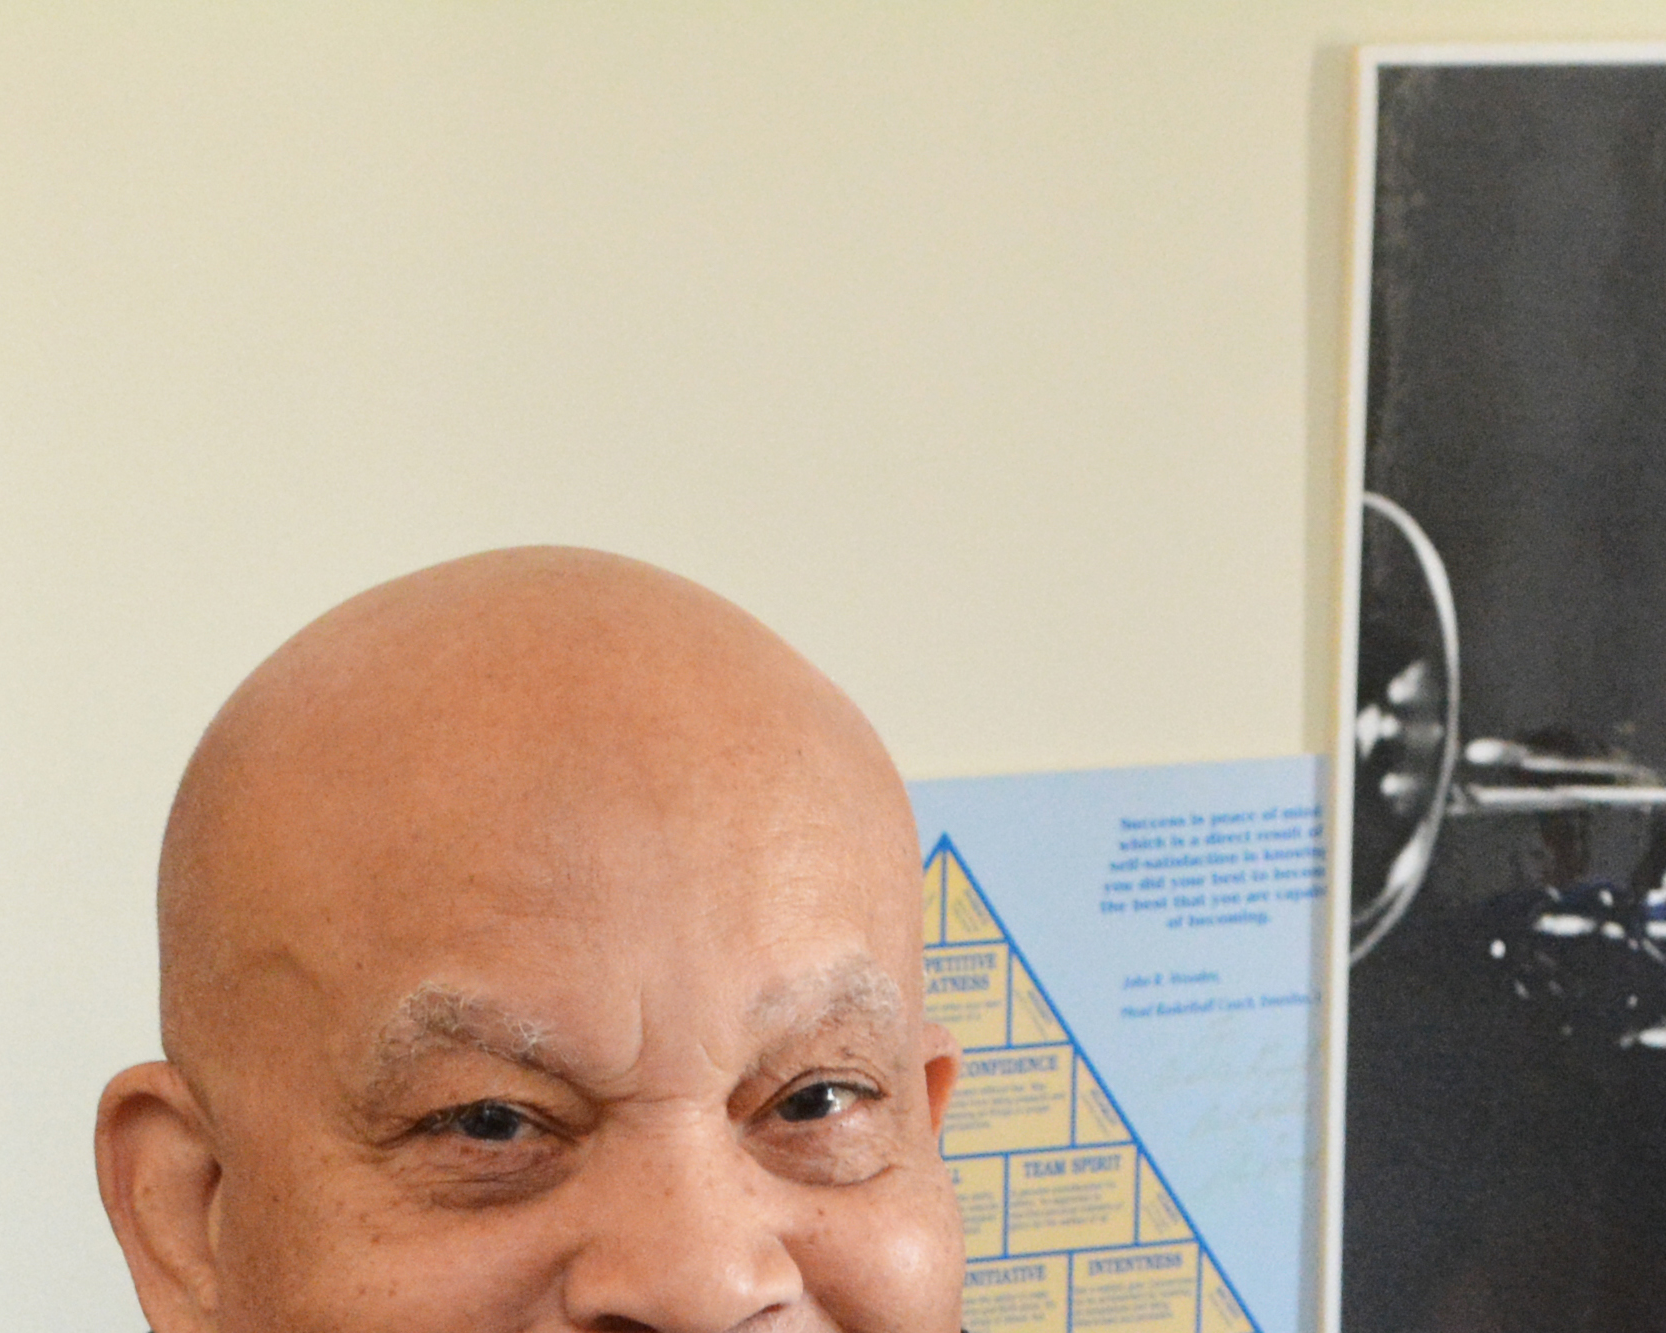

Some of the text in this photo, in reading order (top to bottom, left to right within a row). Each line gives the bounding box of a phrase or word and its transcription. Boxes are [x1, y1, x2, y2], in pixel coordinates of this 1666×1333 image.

[1121, 817, 1185, 830] Success
[1191, 815, 1205, 826] is
[1211, 812, 1255, 828] peace
[1262, 807, 1278, 821] of
[1119, 834, 1165, 851] which
[1170, 834, 1185, 847] is
[1190, 836, 1201, 847] a
[1206, 829, 1251, 846] direct
[1258, 825, 1303, 841] result
[1104, 880, 1133, 895] you
[1138, 876, 1166, 890] did
[1170, 876, 1206, 891] your
[1212, 870, 1247, 886] best
[1251, 869, 1269, 883] to
[1100, 899, 1127, 914] the
[1133, 896, 1168, 913] best
[1173, 893, 1206, 909] that
[1210, 892, 1242, 909] you
[1246, 889, 1270, 903] are
[1166, 915, 1183, 929] of
[1023, 1153, 1122, 1179] TEAM SPIRIT
[1088, 1252, 1182, 1277] INTENTNESS
